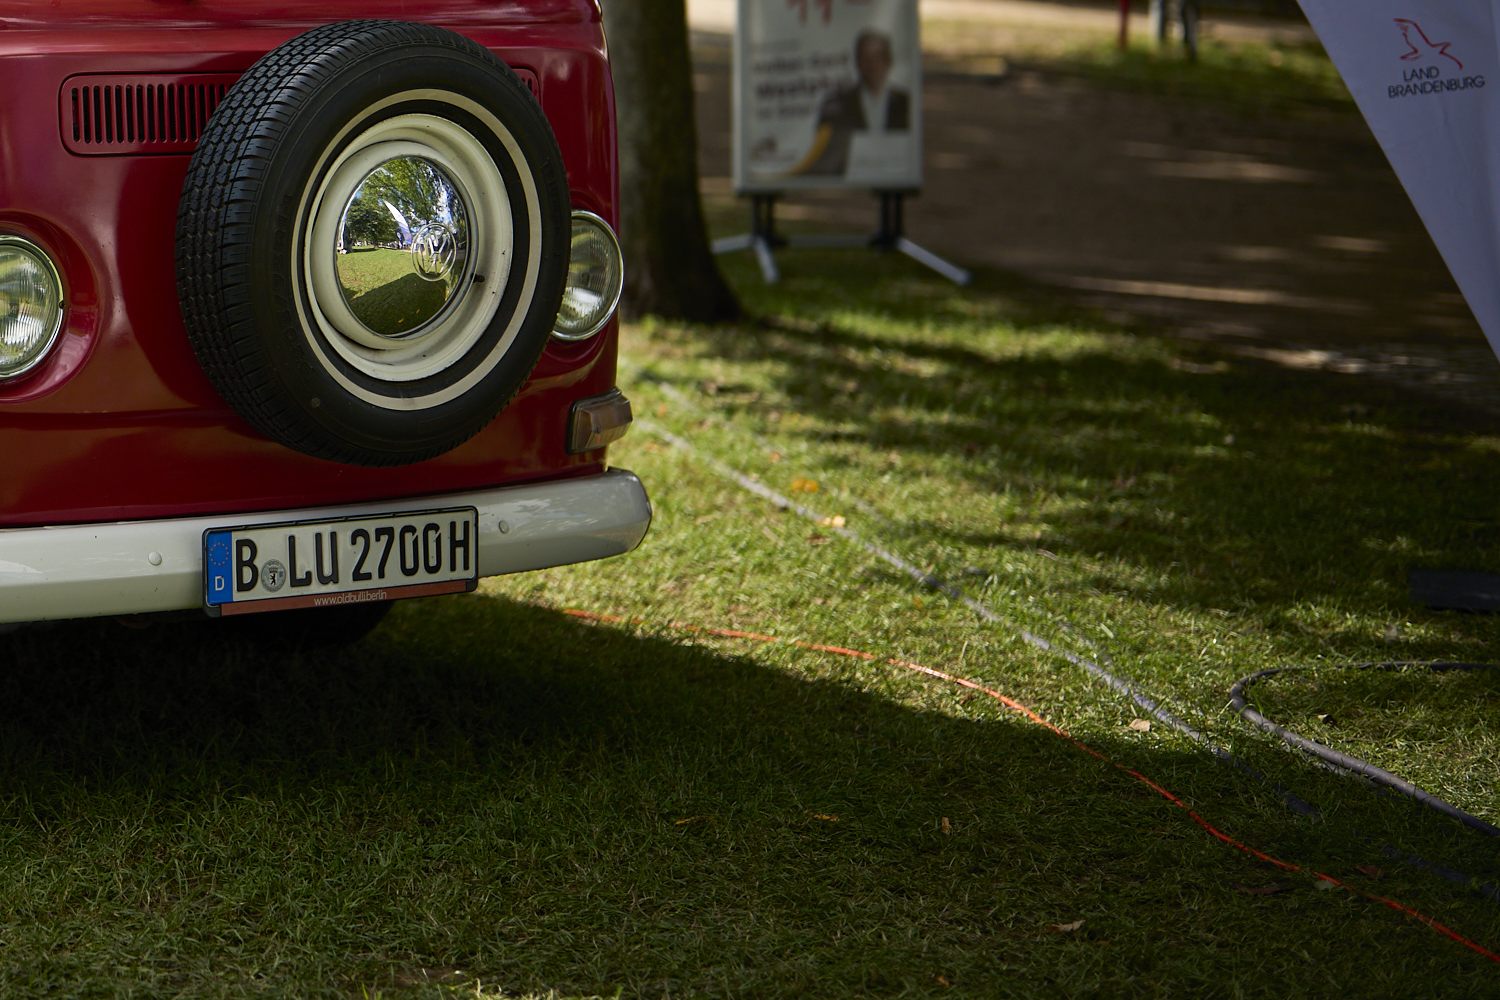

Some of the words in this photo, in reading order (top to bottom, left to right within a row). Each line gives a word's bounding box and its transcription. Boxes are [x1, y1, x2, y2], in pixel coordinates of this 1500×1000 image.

[1403, 66, 1440, 82] LAND
[1388, 75, 1485, 98] BRANDENBURG
[235, 538, 259, 592] B
[287, 531, 339, 588] LU
[350, 520, 470, 582] 2700H
[214, 576, 225, 591] D
